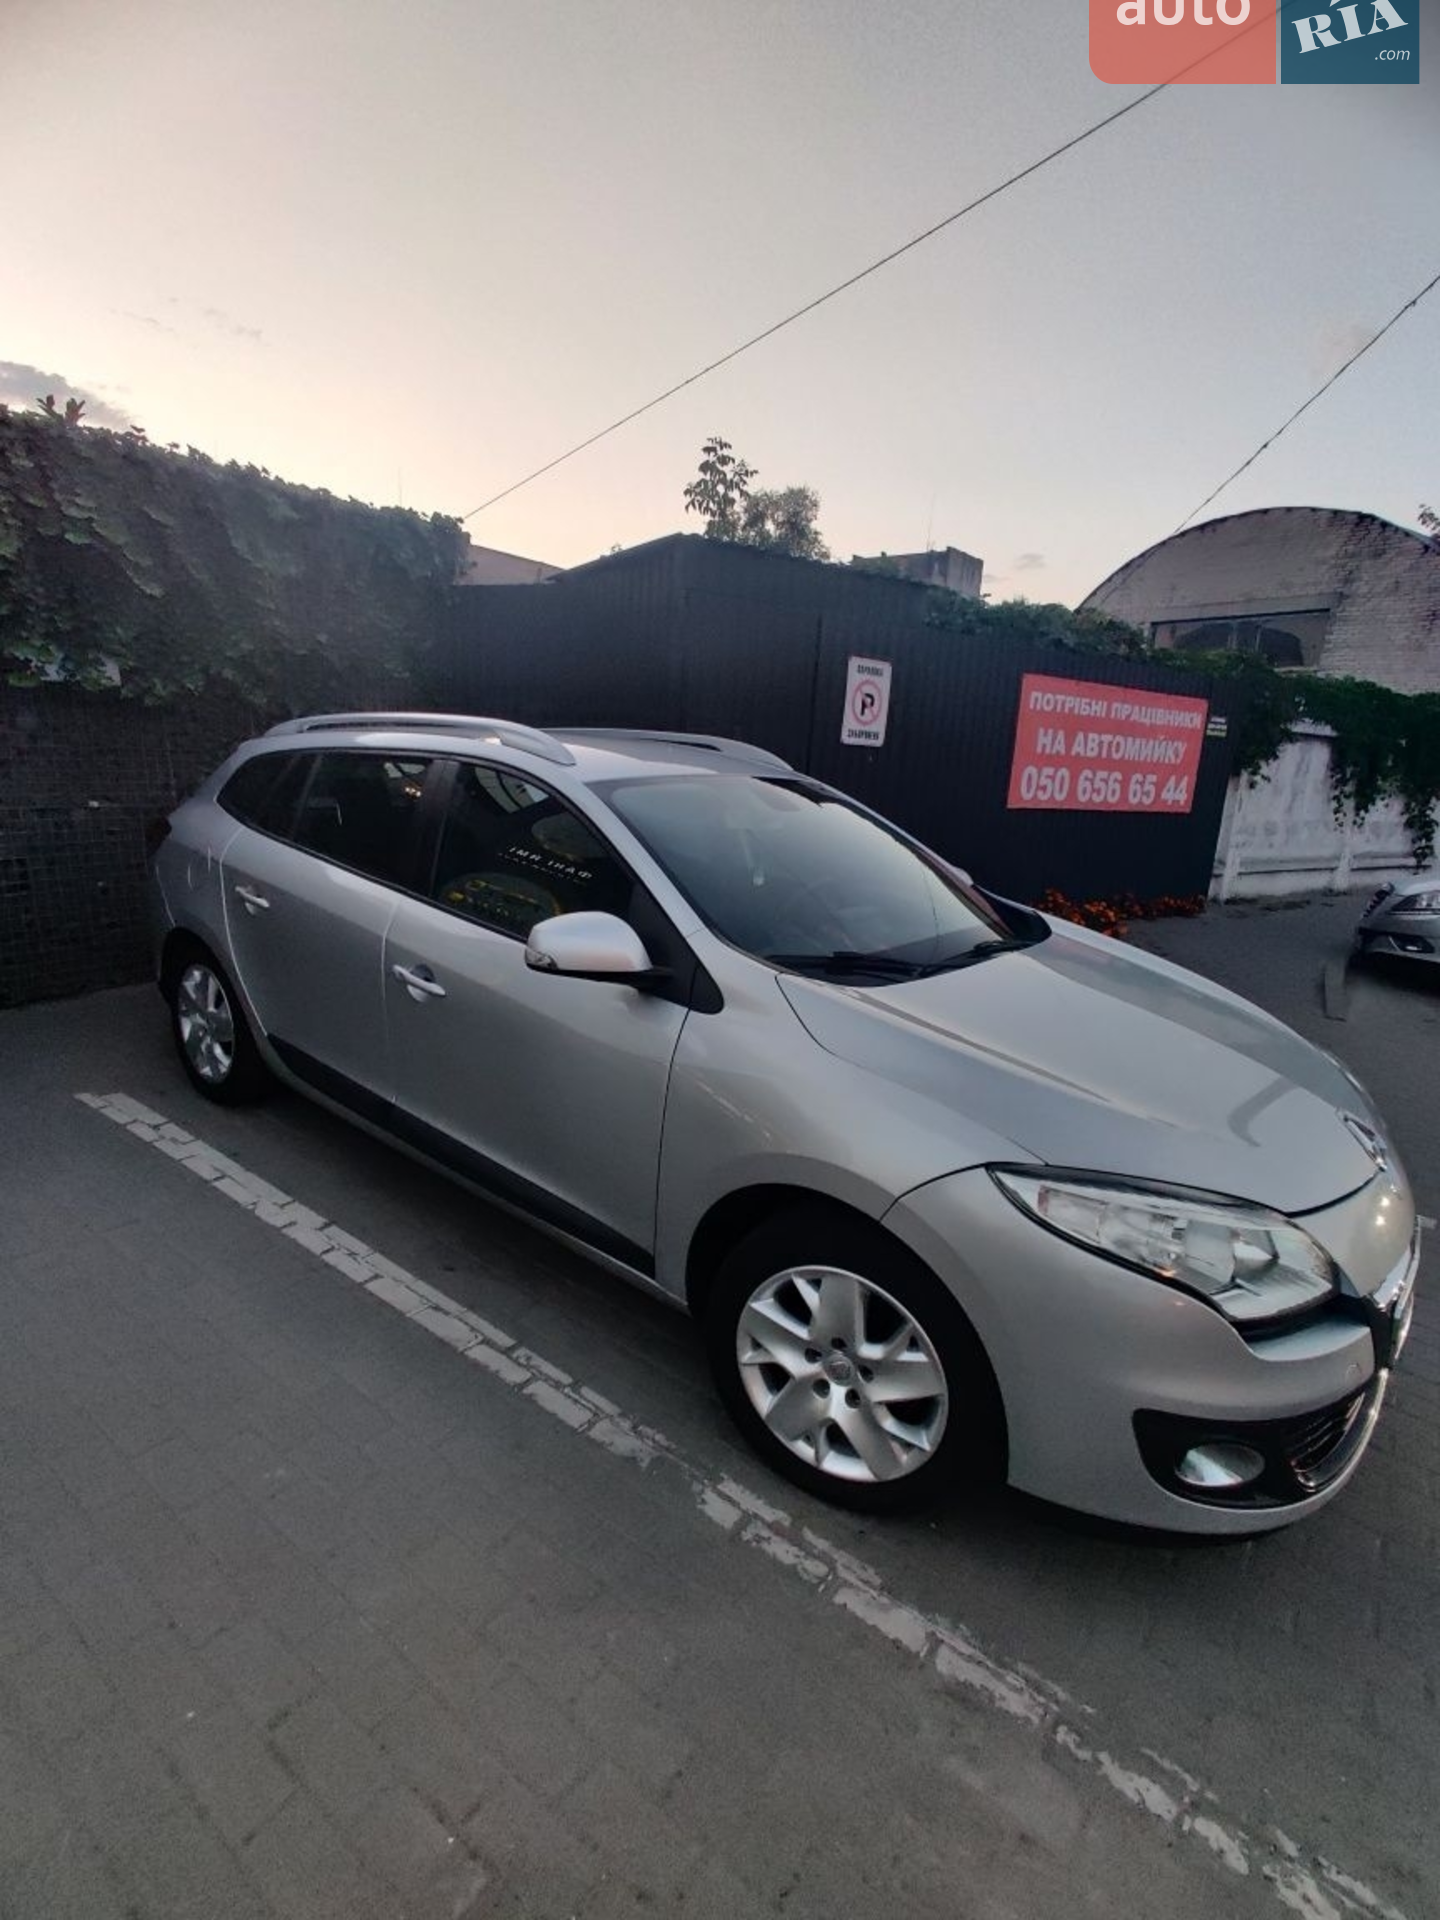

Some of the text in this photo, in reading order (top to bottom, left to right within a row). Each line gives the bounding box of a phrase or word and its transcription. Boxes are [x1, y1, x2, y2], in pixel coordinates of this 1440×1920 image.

[1029, 690, 1108, 719] ПОТРІБНІ
[1110, 701, 1203, 730] ПРАЦІВНИКИ
[1036, 727, 1188, 765] НА АВТОМИЙКУ
[1020, 765, 1189, 806] 050 656 65 44
